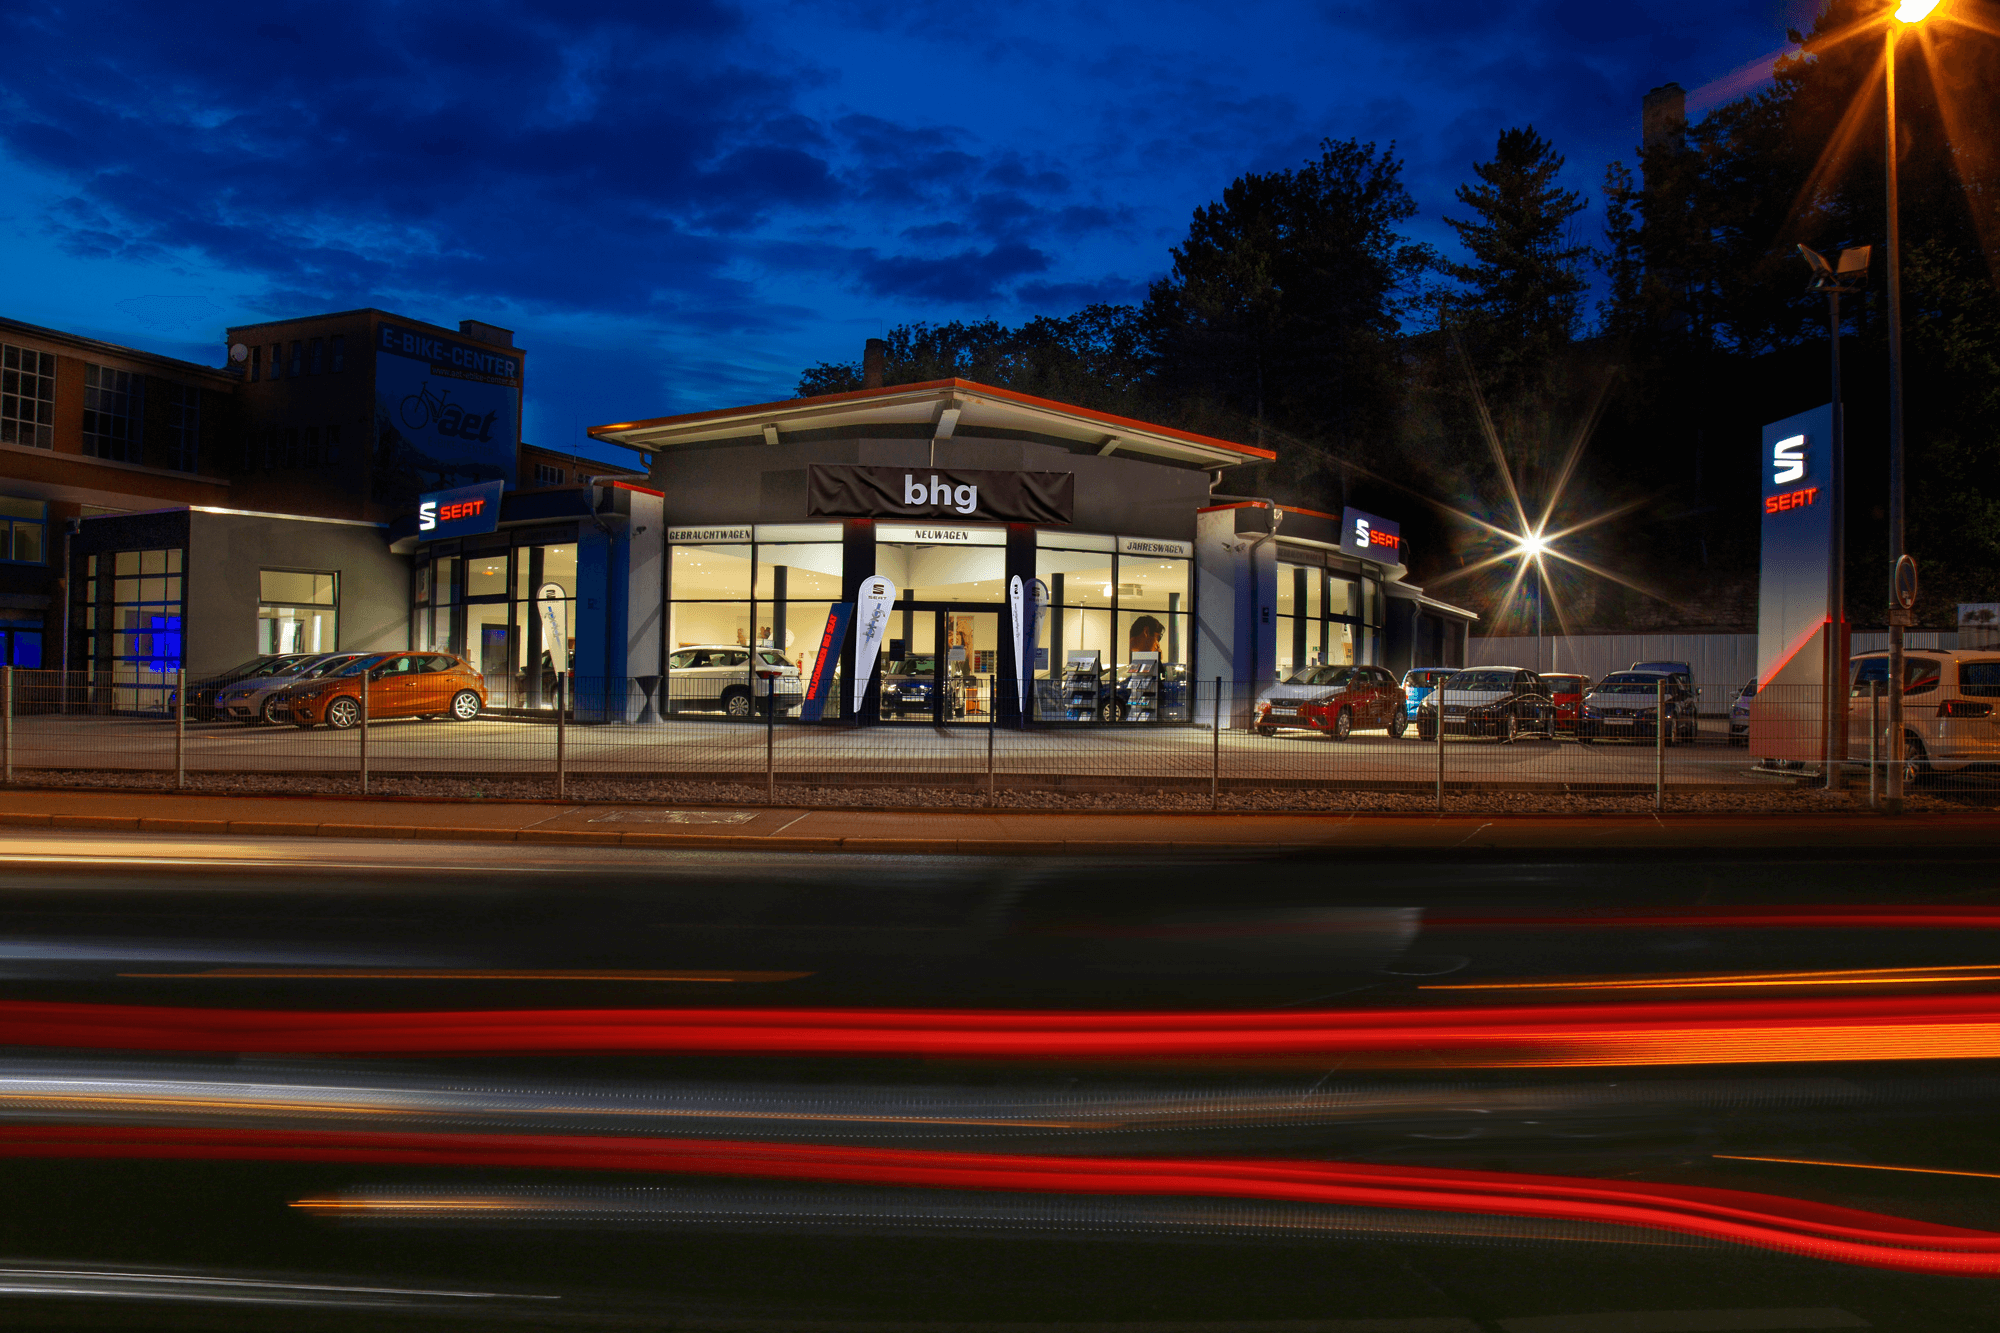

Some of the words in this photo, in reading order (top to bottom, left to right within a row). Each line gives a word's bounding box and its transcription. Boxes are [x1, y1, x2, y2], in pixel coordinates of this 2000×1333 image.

[382, 328, 515, 378] E-BIKE-CENTER
[431, 366, 518, 387] www.aet-ebike-center.de
[438, 409, 498, 443] aet
[904, 473, 978, 515] bhg
[1765, 487, 1818, 514] SEAT
[440, 499, 485, 521] SEAT
[669, 529, 751, 541] GEBRAUCHTWAGEN
[914, 529, 969, 540] NEUWAGEN
[1370, 529, 1400, 549] SEAT
[1126, 541, 1185, 555] JAHRESWAGEN
